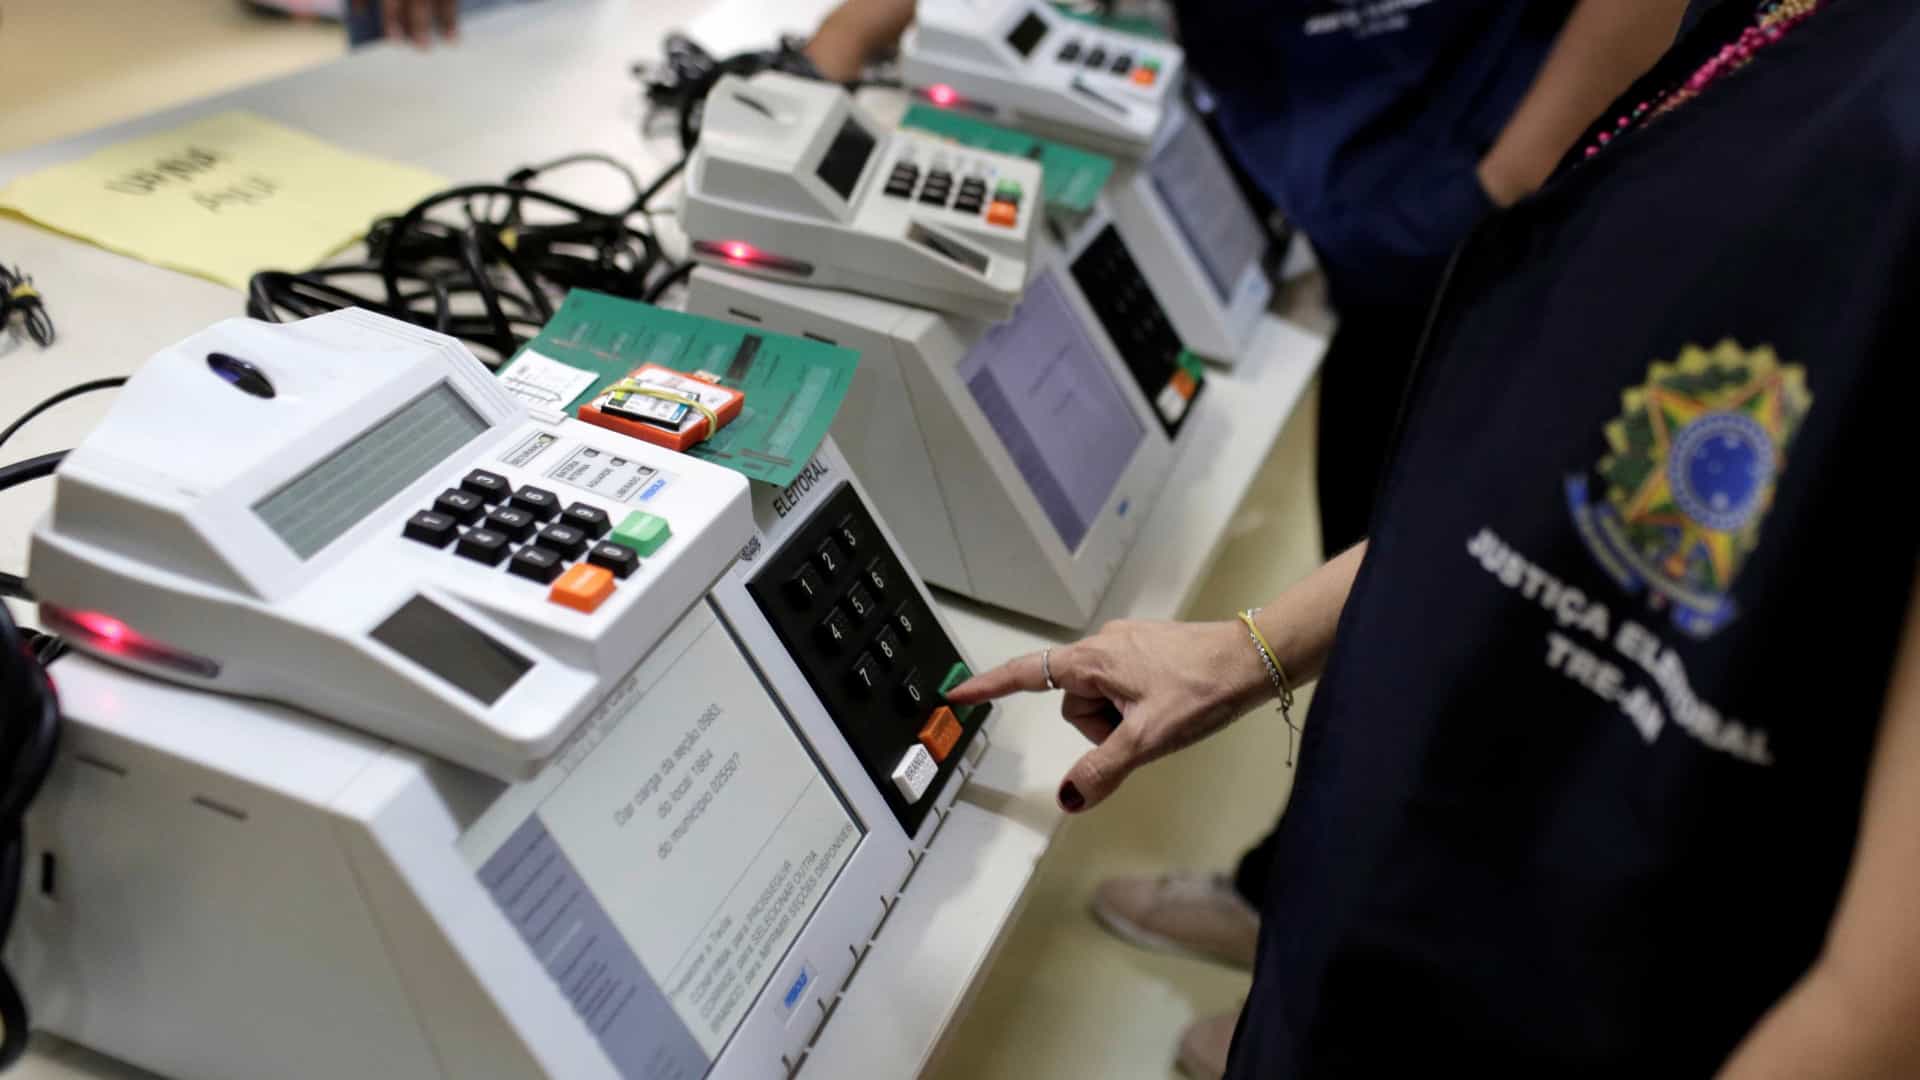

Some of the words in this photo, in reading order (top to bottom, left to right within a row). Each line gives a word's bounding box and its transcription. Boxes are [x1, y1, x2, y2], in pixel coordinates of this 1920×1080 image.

[773, 457, 829, 518] ELEITORAL
[422, 516, 441, 525] 1
[450, 495, 469, 505] 2
[476, 474, 495, 485] 3
[500, 512, 519, 522] 5
[526, 552, 545, 562] 7
[603, 547, 622, 557] 0
[802, 579, 813, 596] 1
[822, 552, 835, 571] 2
[844, 529, 856, 546] 3
[1466, 526, 1610, 640] JUSTIÇA
[831, 623, 842, 641] 4
[852, 597, 864, 615] 5
[871, 571, 884, 589] 6
[858, 667, 872, 687] 7
[881, 641, 893, 658] 8
[900, 616, 912, 632] 9
[908, 684, 920, 701] 0
[661, 757, 675, 775] da
[658, 800, 672, 819] do
[658, 840, 673, 860] do
